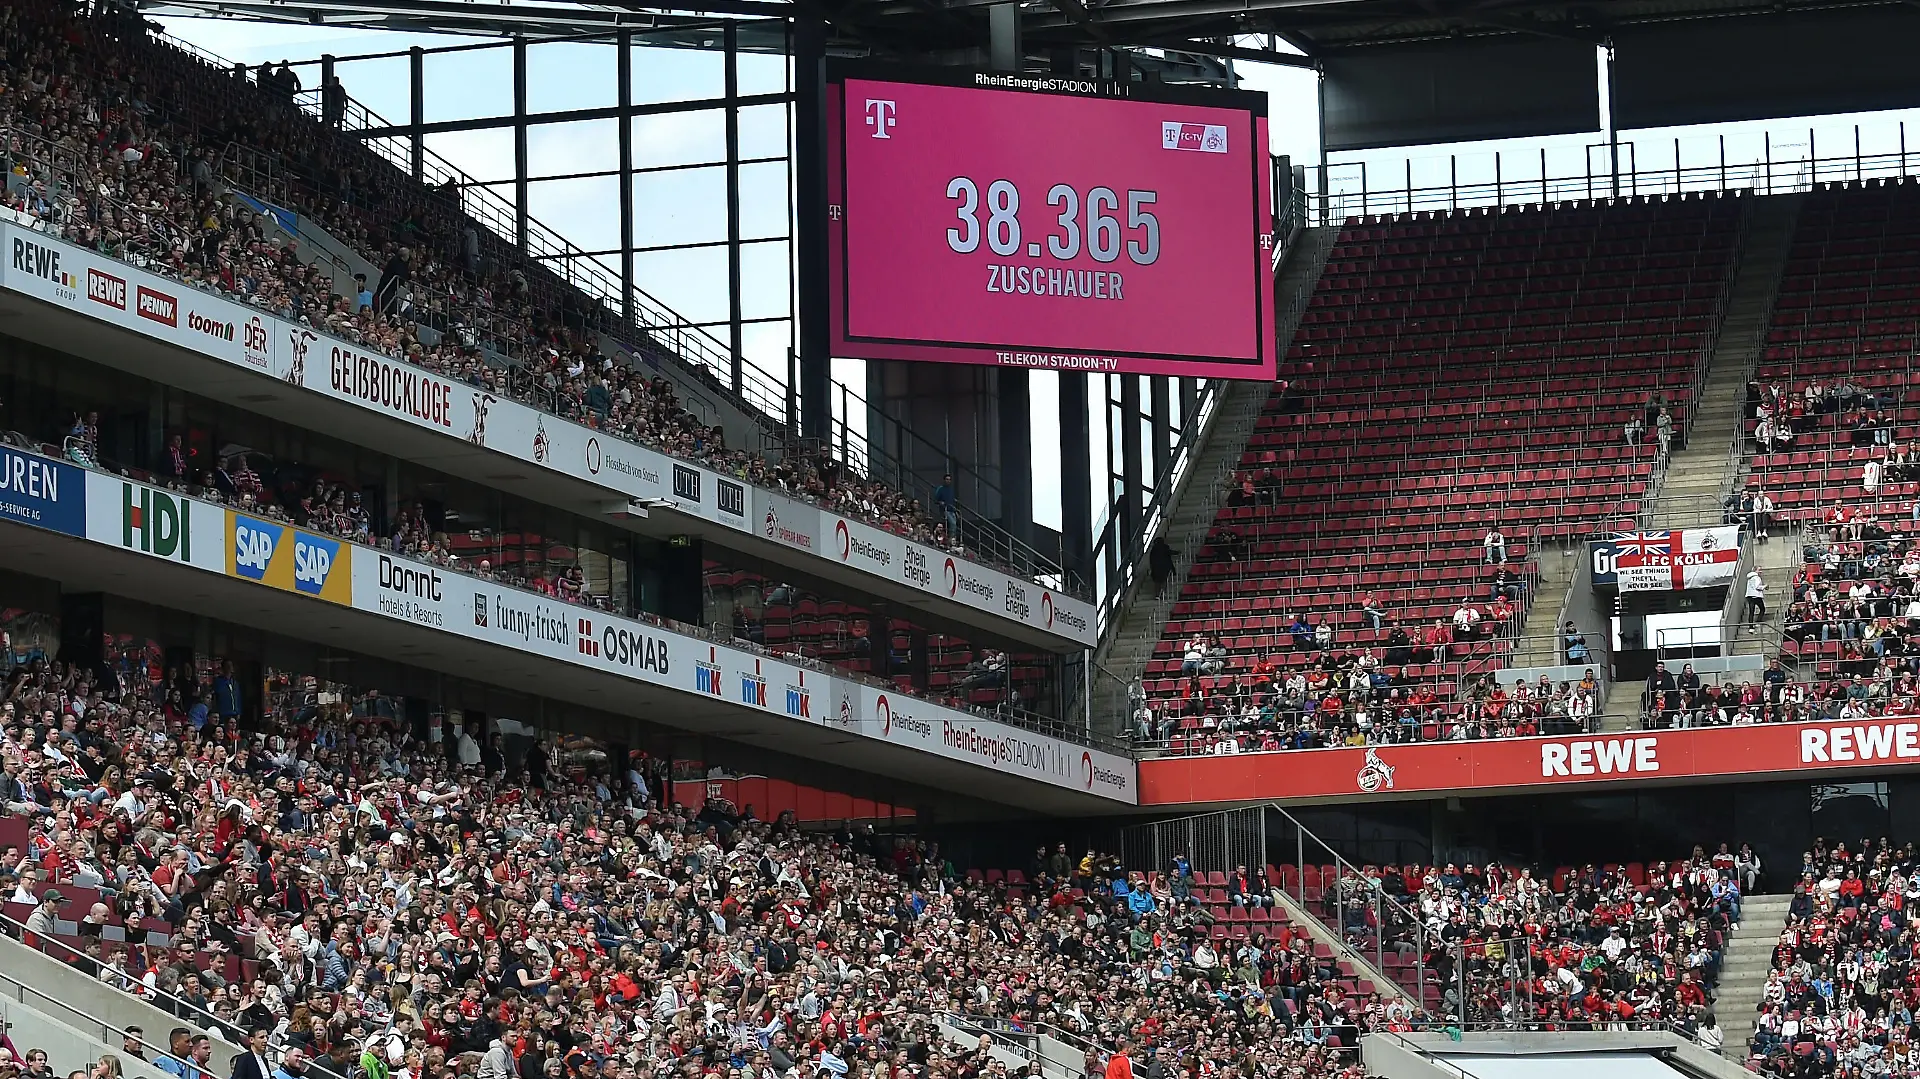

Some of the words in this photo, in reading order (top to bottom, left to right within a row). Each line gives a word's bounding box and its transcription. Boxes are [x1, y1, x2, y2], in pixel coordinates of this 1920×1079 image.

[975, 73, 1097, 94] RheinEnergieSTADION
[1180, 132, 1203, 142] FC-TV
[945, 176, 1161, 266] 38.365
[13, 237, 61, 283] REWE
[55, 287, 77, 302] GROUP
[89, 273, 124, 306] REWE
[986, 264, 1124, 300] ZUSCHAUER
[188, 310, 225, 339] toom
[244, 321, 268, 354] DER
[996, 352, 1048, 367] TELEKOM
[1050, 355, 1118, 370] STADION-TV
[675, 468, 699, 498] UTH
[719, 483, 742, 513] UTH
[31, 509, 41, 521] AG
[122, 481, 191, 563] HDI
[235, 525, 273, 571] SAP
[850, 536, 891, 567] RheinEnergie
[905, 544, 926, 567] Rhein
[1674, 553, 1714, 566] KÖLN
[294, 541, 330, 586] SAP
[379, 554, 442, 602] Dorint
[903, 562, 931, 587] Energie
[957, 573, 994, 601] RheinEnergie
[1007, 580, 1026, 602] Rhein
[379, 593, 404, 618] Hotels
[405, 602, 412, 619] &
[413, 603, 443, 627] Resorts
[496, 594, 569, 646] funny-frisch
[1005, 594, 1030, 621] Energie
[1054, 606, 1087, 632] RheinEnergie
[603, 625, 669, 675] OSMAB
[891, 711, 931, 739] RheinEnergie
[1541, 737, 1659, 777] REWE
[1801, 723, 1920, 763] REWE
[1093, 765, 1126, 789] RheinEnergie
